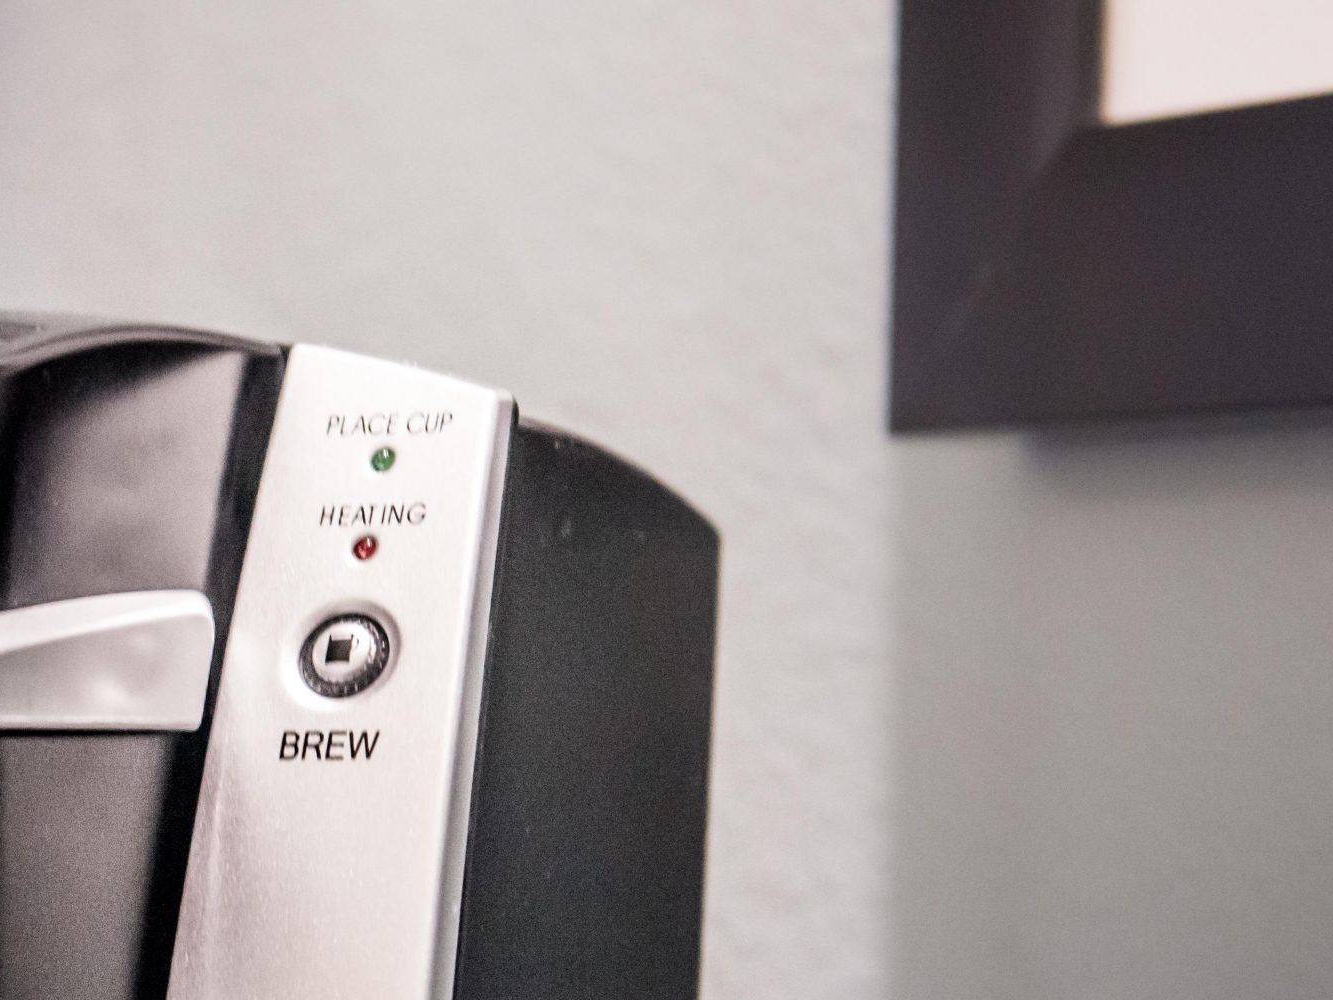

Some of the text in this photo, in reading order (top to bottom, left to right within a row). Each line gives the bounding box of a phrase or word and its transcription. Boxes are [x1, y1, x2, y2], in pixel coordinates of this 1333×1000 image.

[326, 411, 453, 437] PLACE CUP
[319, 503, 427, 528] HEATING
[279, 730, 380, 761] BREW
